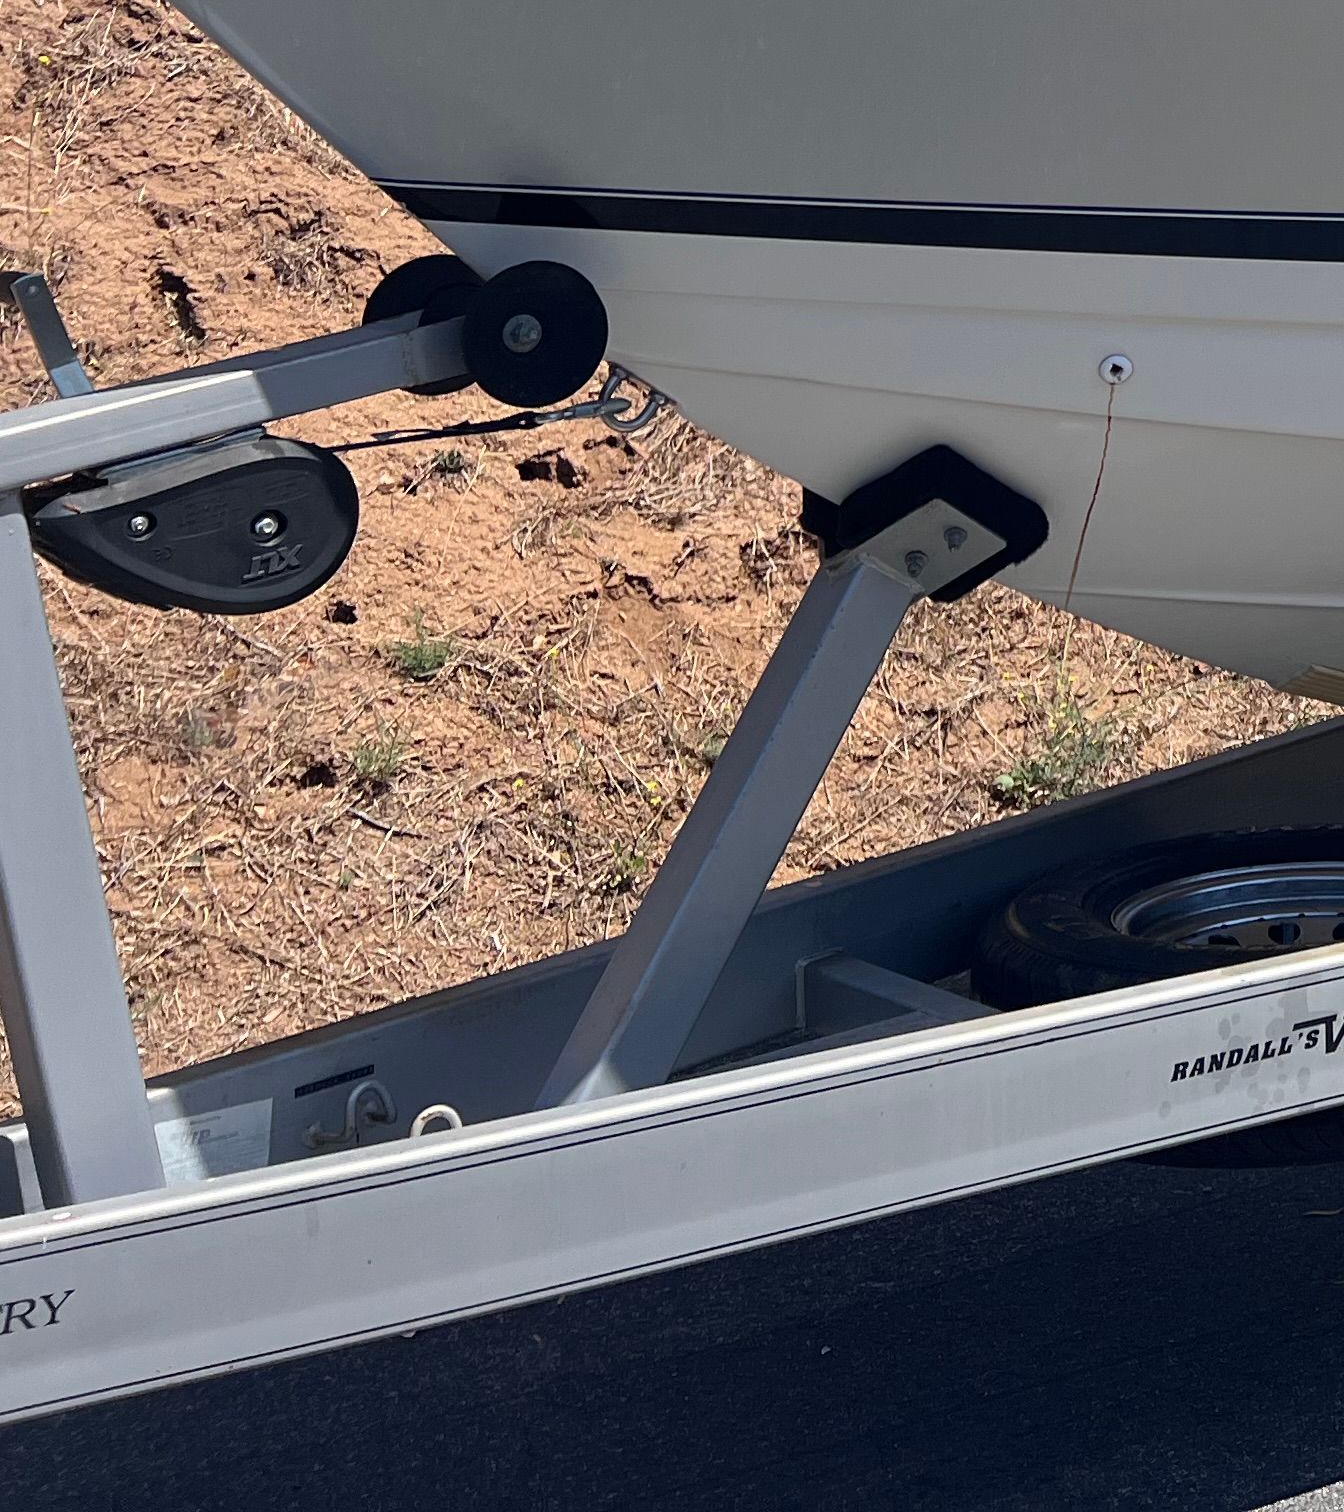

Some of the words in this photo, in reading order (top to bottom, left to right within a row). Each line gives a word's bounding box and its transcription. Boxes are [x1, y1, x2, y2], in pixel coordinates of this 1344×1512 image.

[241, 543, 303, 580] XLT
[1170, 1029, 1320, 1082] RANDALL'S
[0, 1289, 76, 1335] RY
